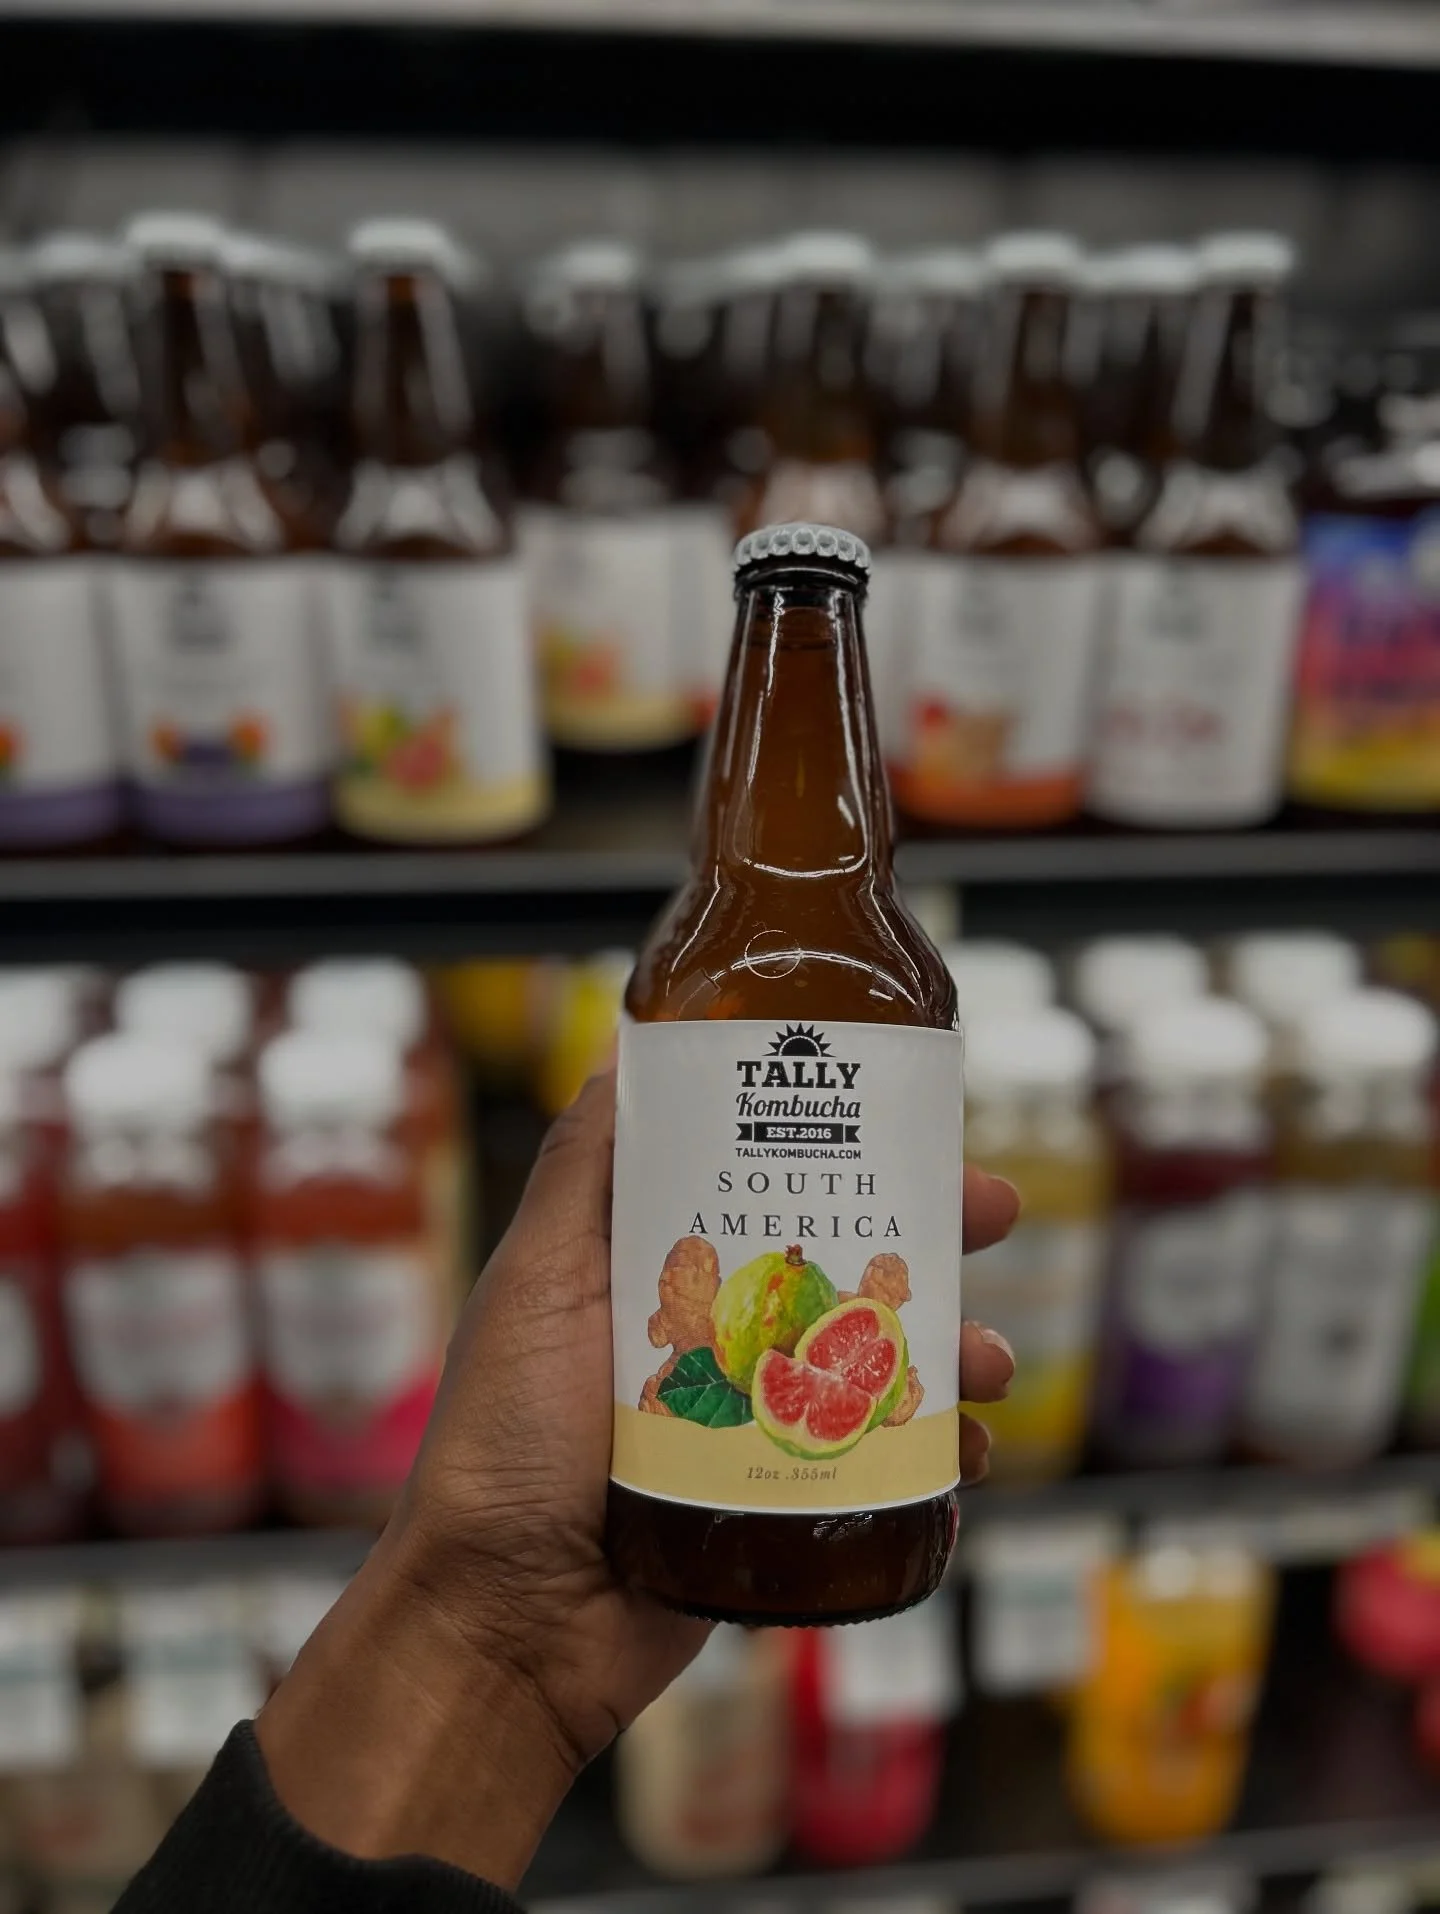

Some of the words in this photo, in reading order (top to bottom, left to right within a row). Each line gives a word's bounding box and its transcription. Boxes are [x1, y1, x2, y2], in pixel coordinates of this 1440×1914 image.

[737, 1061, 861, 1089] TALLY
[736, 1092, 861, 1118] Kombucha
[766, 1127, 832, 1139] EST.2016
[736, 1148, 861, 1159] TALLYKOMBUCHA.COM
[717, 1171, 876, 1195] SOUTH
[689, 1212, 902, 1238] AMERICA
[747, 1466, 780, 1480] 12oz
